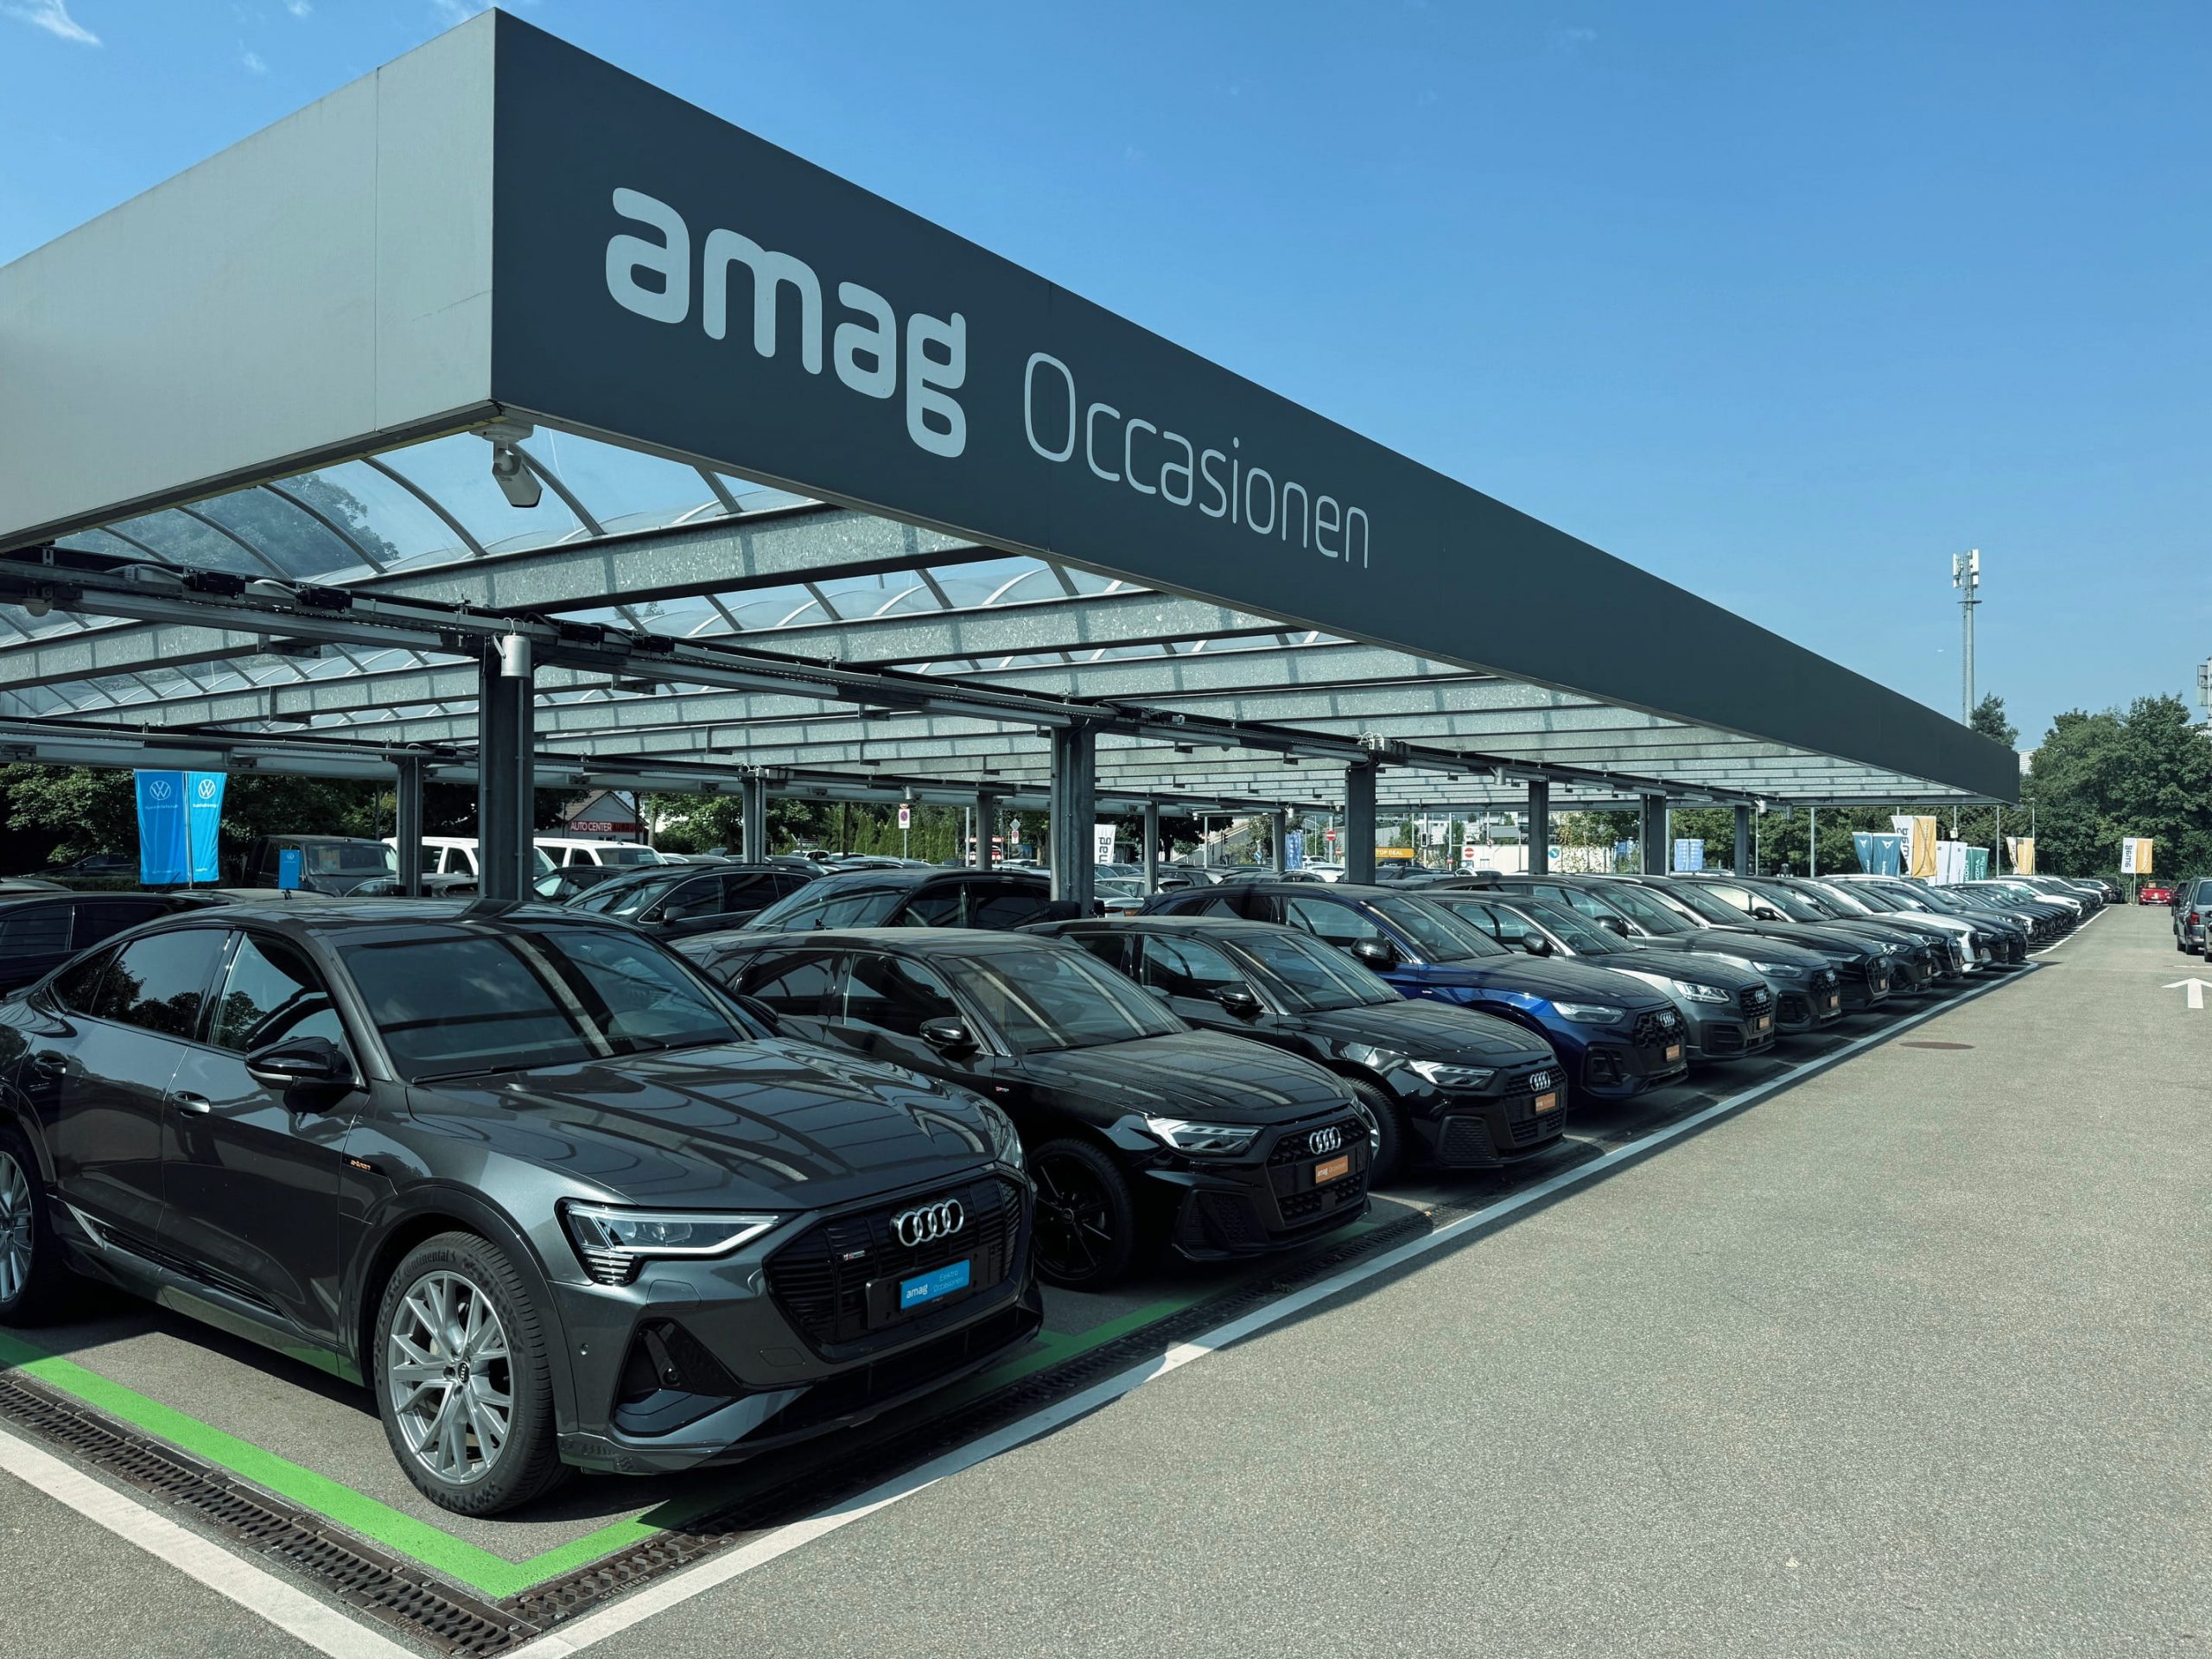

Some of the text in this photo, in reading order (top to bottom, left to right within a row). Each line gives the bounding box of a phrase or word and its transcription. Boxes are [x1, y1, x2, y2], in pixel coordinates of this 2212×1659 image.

[606, 188, 1369, 569] amag Occasionen
[570, 822, 588, 831] AUTO
[588, 823, 612, 831] CENTER
[1098, 836, 1112, 864] mag
[906, 1283, 928, 1299] amag
